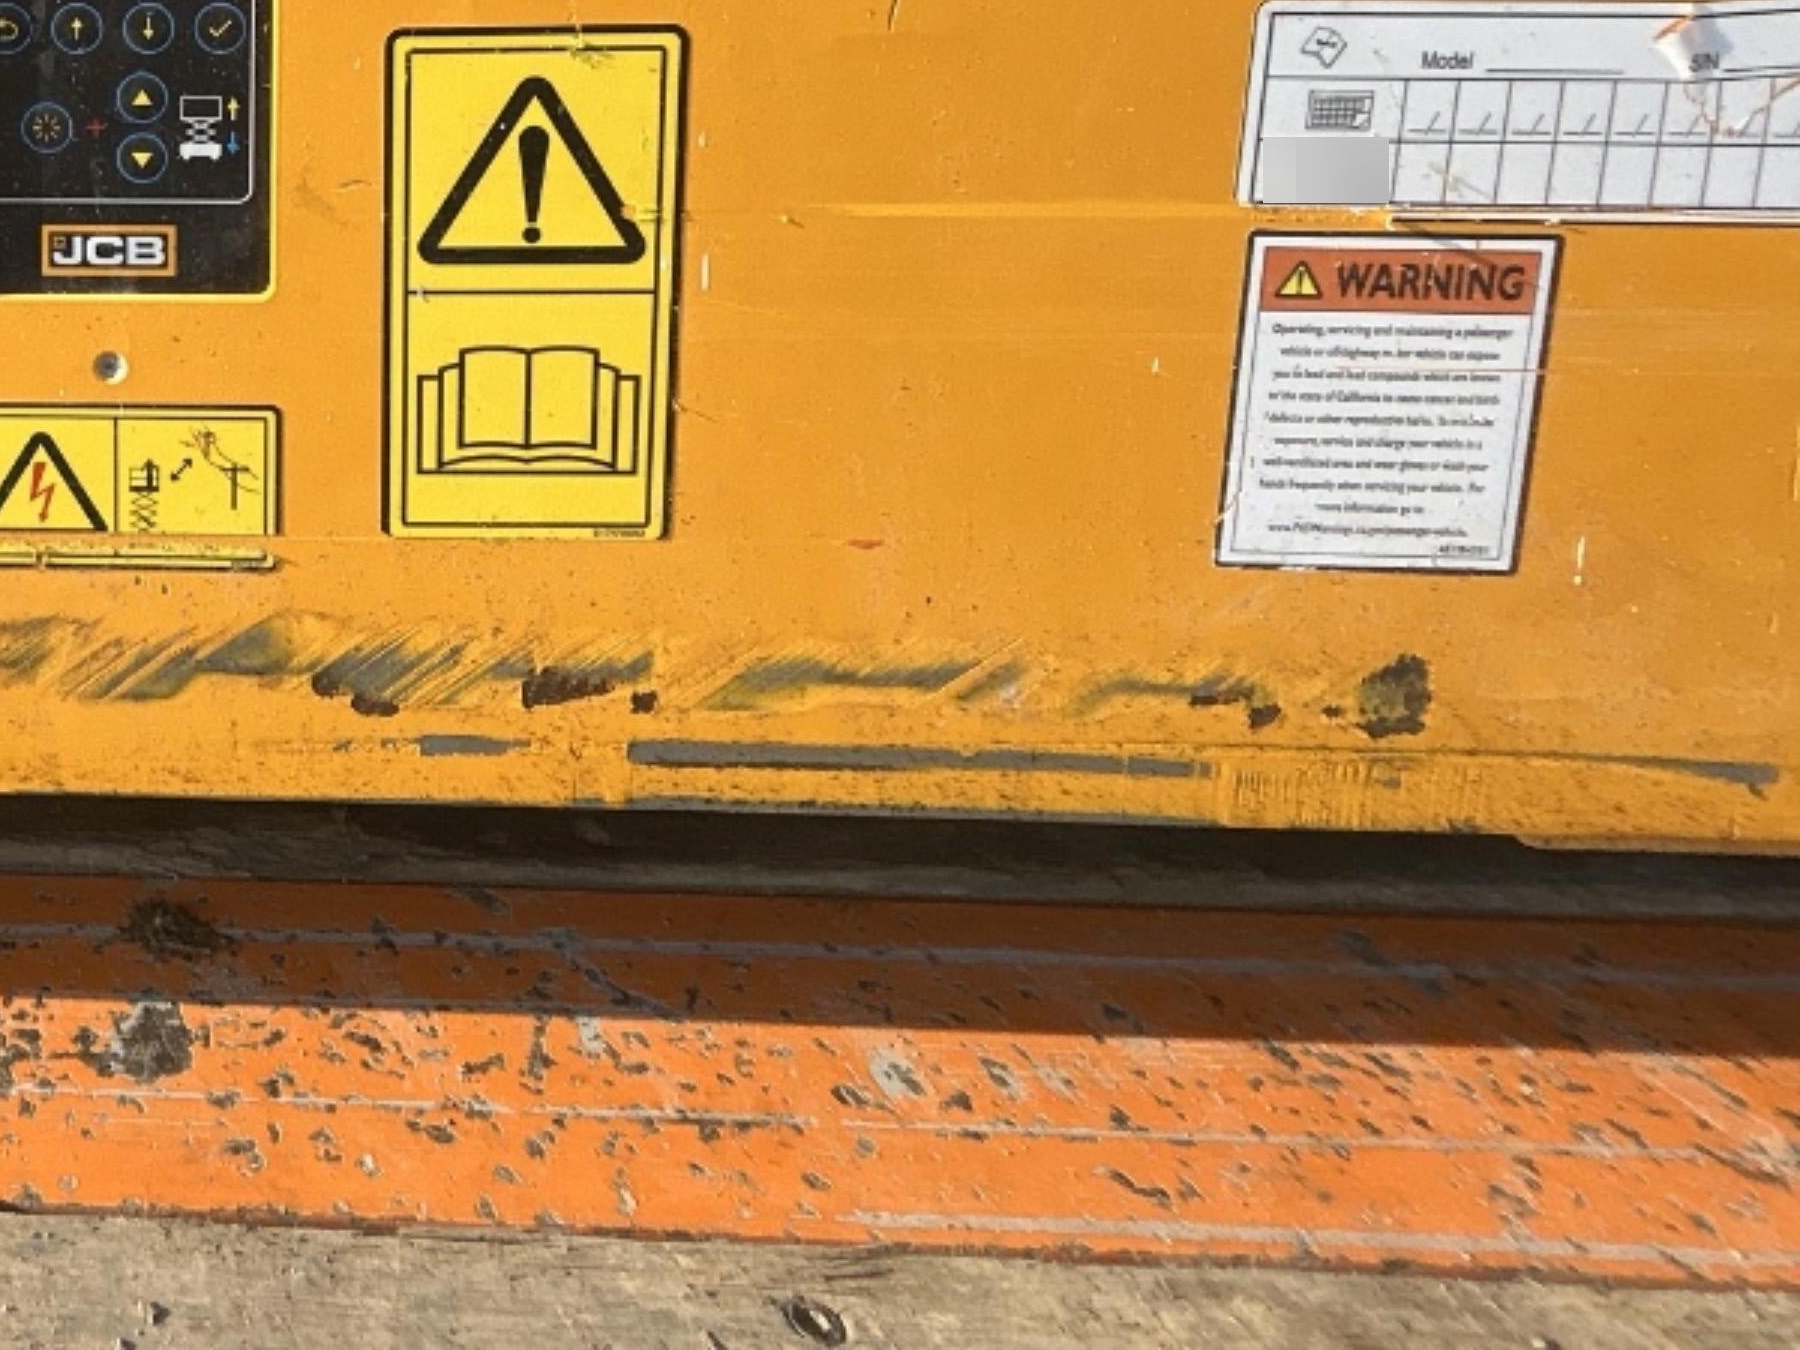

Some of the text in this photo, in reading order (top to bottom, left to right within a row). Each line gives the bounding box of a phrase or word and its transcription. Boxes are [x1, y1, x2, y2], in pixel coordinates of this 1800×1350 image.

[1420, 49, 1475, 70] Model
[52, 235, 166, 266] JCB
[1337, 262, 1526, 301] WARNING
